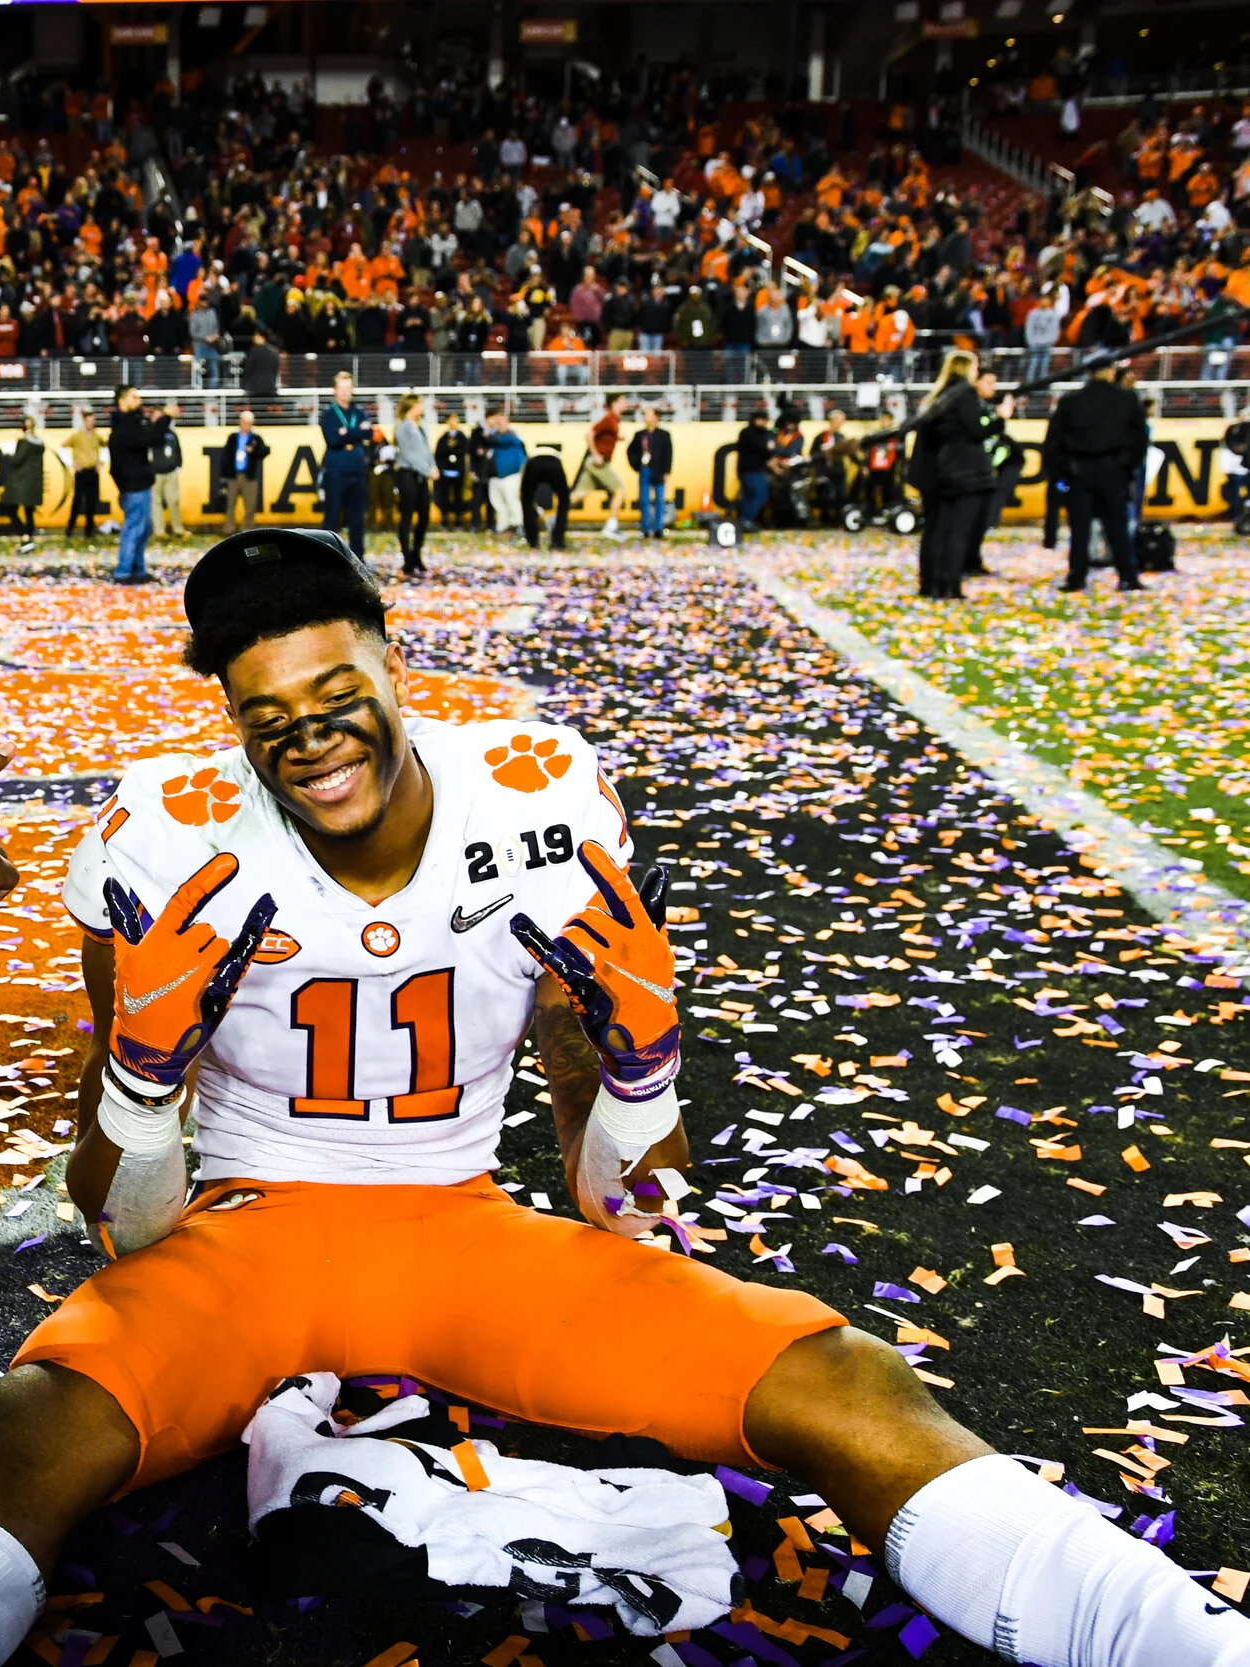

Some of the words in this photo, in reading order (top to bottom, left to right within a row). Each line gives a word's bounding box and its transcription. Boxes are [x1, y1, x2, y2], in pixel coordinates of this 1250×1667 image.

[464, 823, 575, 884] 2019
[260, 936, 294, 951] CC
[288, 966, 465, 1125] 11
